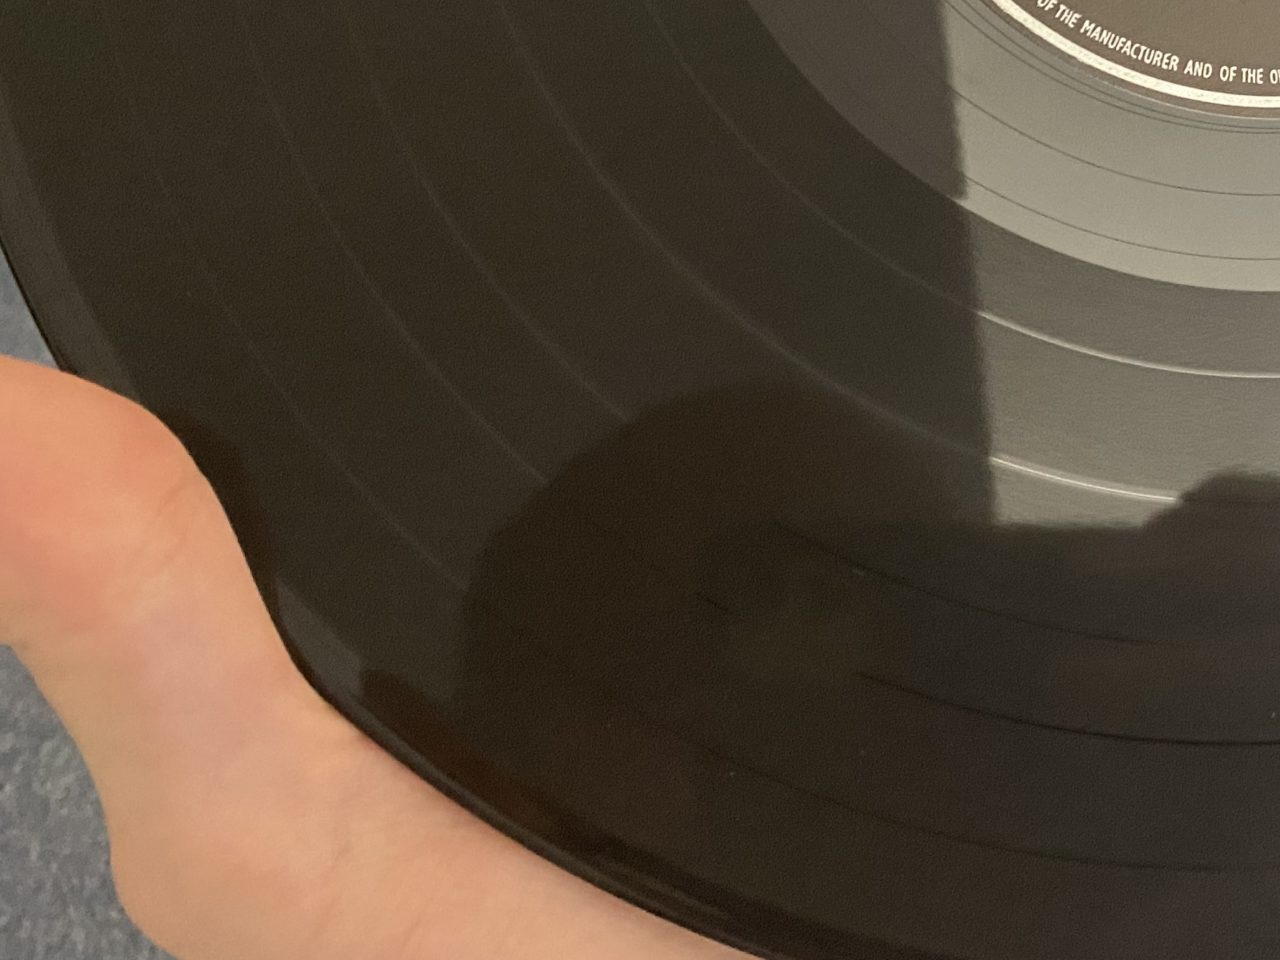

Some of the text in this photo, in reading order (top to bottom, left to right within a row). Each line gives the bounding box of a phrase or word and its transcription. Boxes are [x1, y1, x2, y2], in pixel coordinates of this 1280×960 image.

[1054, 4, 1083, 29] THE
[1080, 20, 1180, 72] MANUFACTURER
[1184, 59, 1212, 79] AND
[1219, 65, 1237, 82] OF
[1241, 67, 1264, 84] THE
